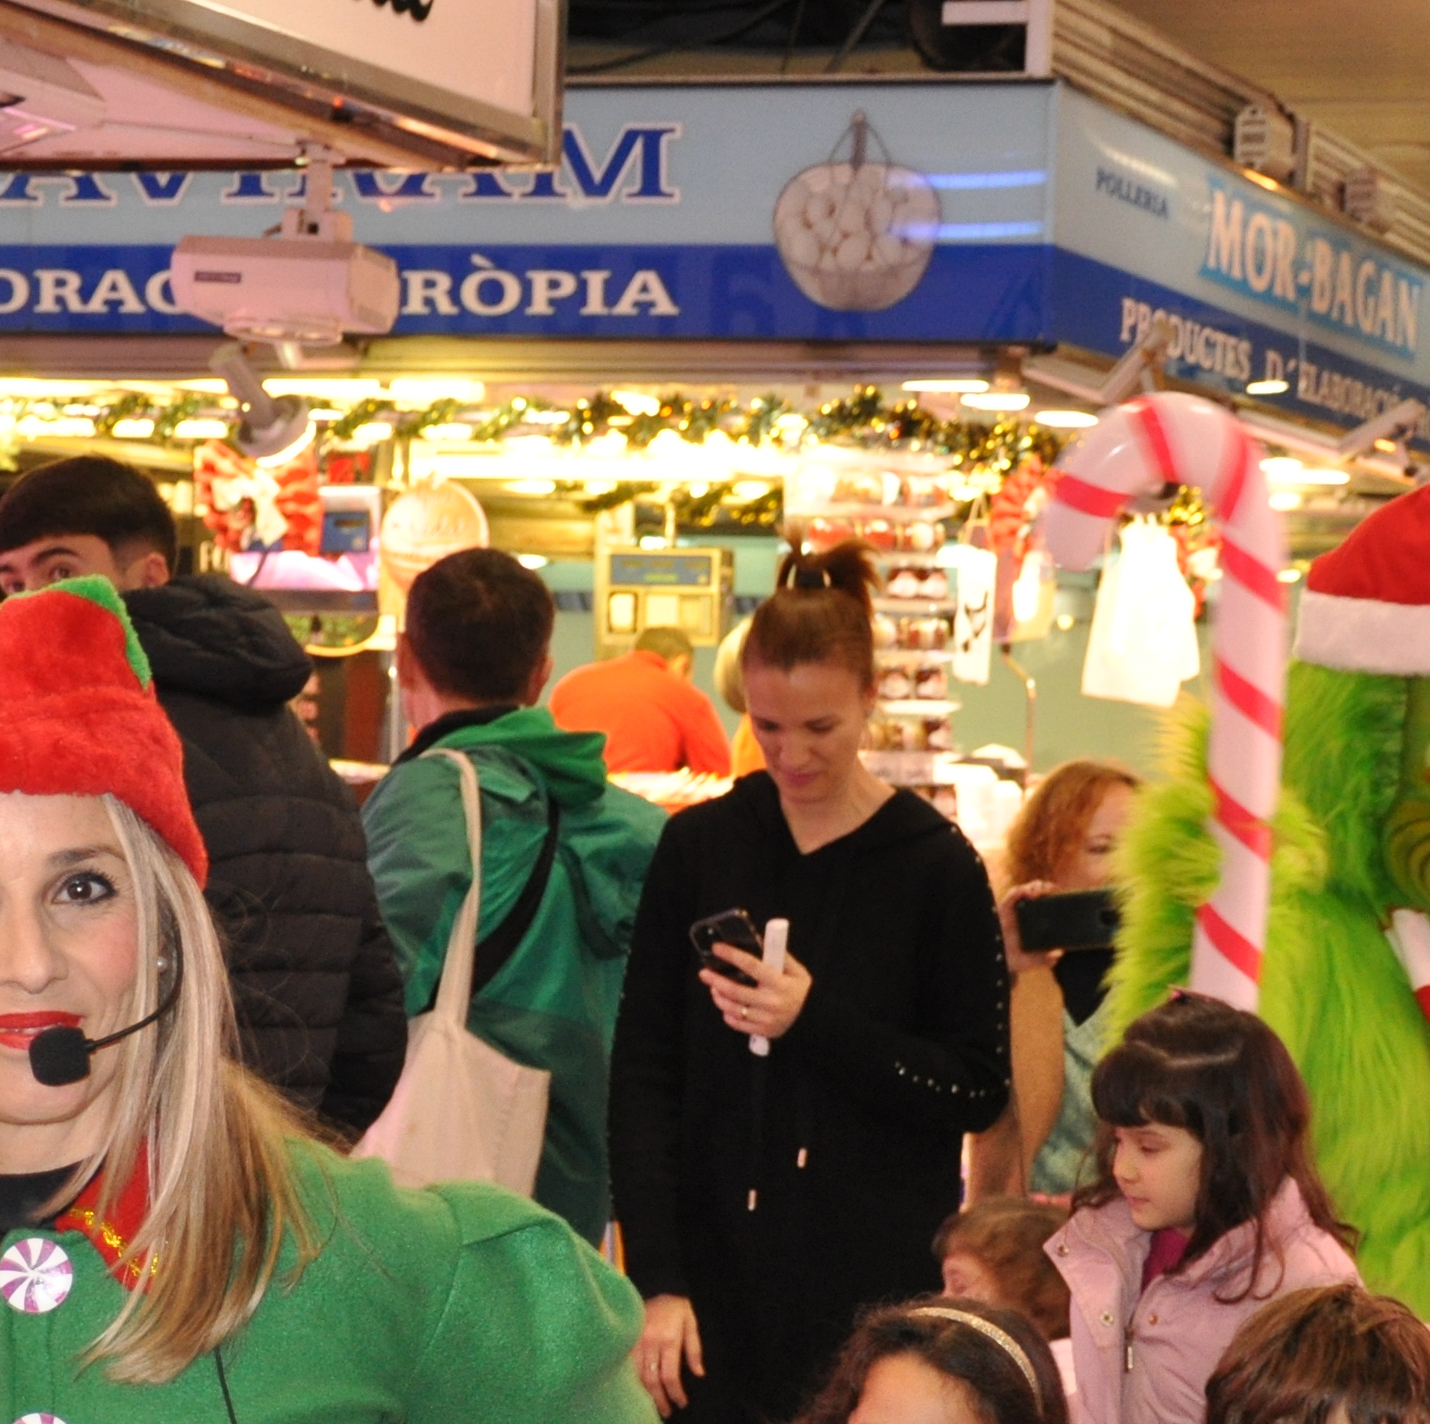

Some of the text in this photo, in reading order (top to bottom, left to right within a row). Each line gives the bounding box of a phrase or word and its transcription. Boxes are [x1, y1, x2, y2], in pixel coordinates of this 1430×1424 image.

[1095, 166, 1169, 220] POLLERIA
[400, 253, 681, 316] RÒPIA
[1207, 189, 1422, 352] MOR-BAGAN
